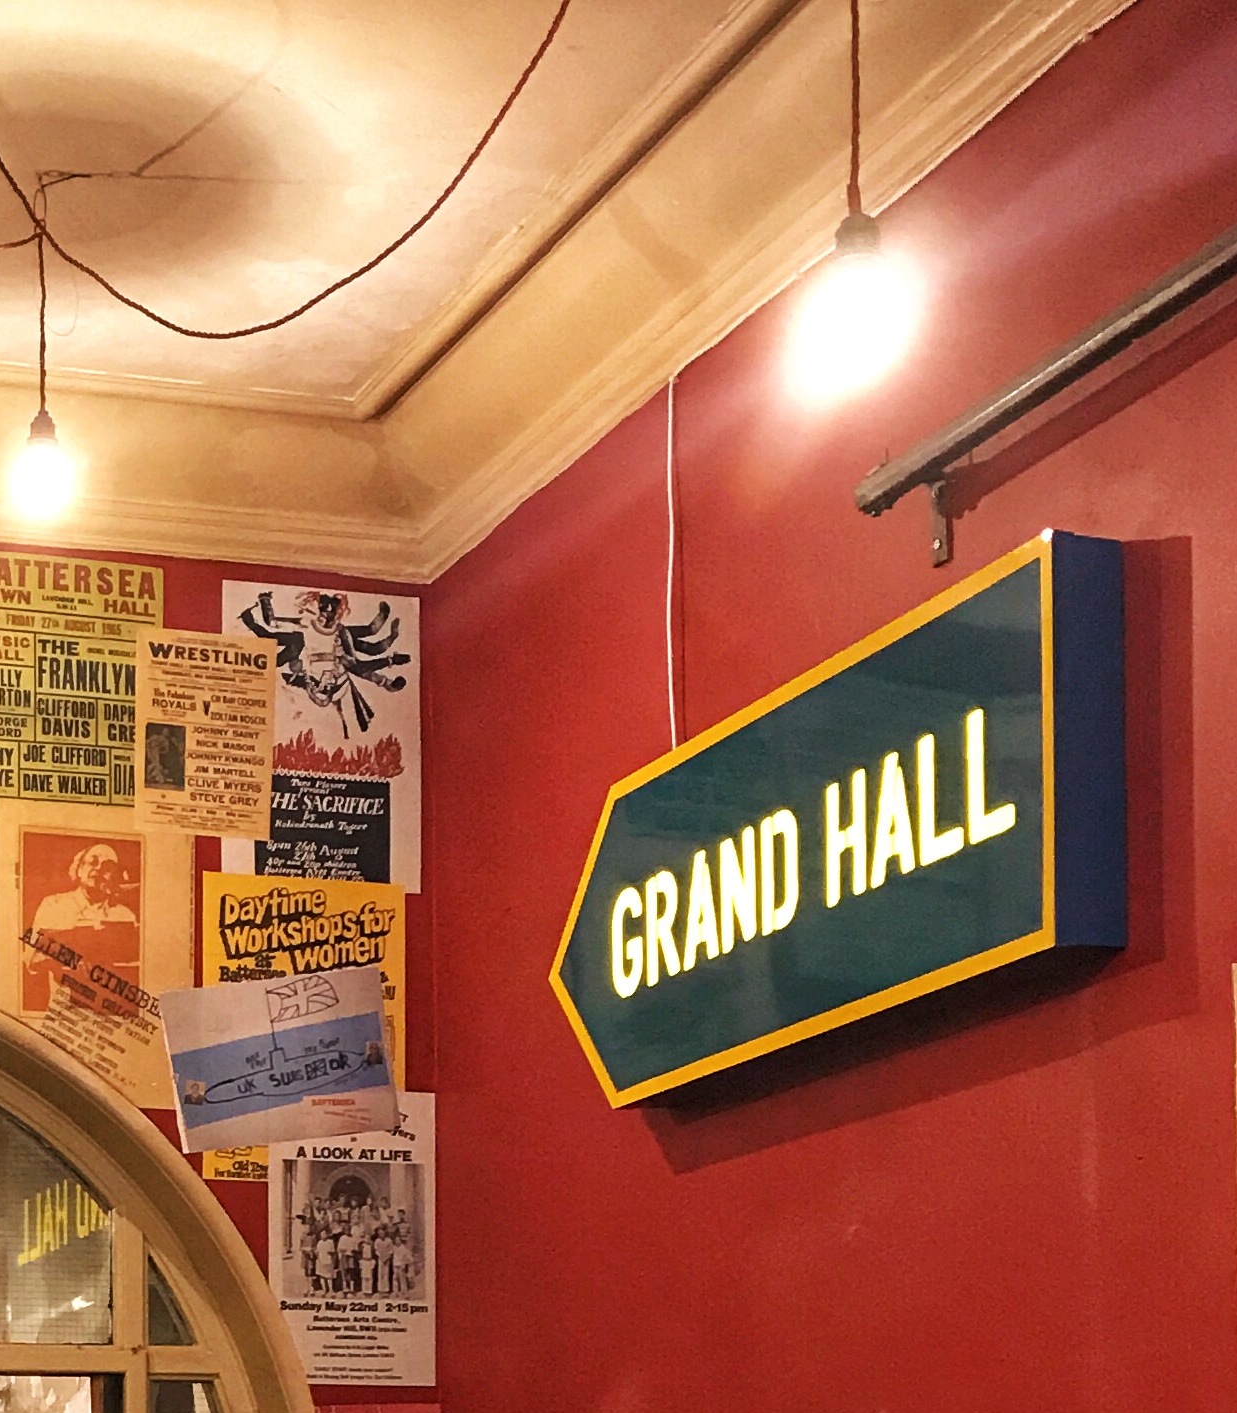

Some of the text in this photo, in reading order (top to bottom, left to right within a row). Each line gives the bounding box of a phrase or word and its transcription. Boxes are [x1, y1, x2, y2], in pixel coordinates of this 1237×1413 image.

[103, 599, 156, 617] HALL
[37, 639, 80, 657] THE
[148, 641, 267, 670] WRESTLING
[38, 656, 136, 696] FRANKLYN
[37, 697, 96, 719] CLIFFORD
[41, 716, 91, 739] DAVIS
[23, 744, 107, 767] JOE CLIFFORD
[23, 773, 107, 797] DAVE WALKER
[187, 777, 262, 793] CLIVE MYERS
[189, 792, 259, 807] STEVE GREY
[304, 796, 384, 815] SACRIFICE
[609, 706, 1018, 1000] GRAND HALL
[220, 886, 327, 926] Daytime
[219, 900, 397, 961] Workshops for
[19, 927, 84, 971] ALLEN
[284, 935, 385, 975] women
[312, 1146, 413, 1162] LOOK AT LIFE
[348, 1302, 379, 1313] 22nd
